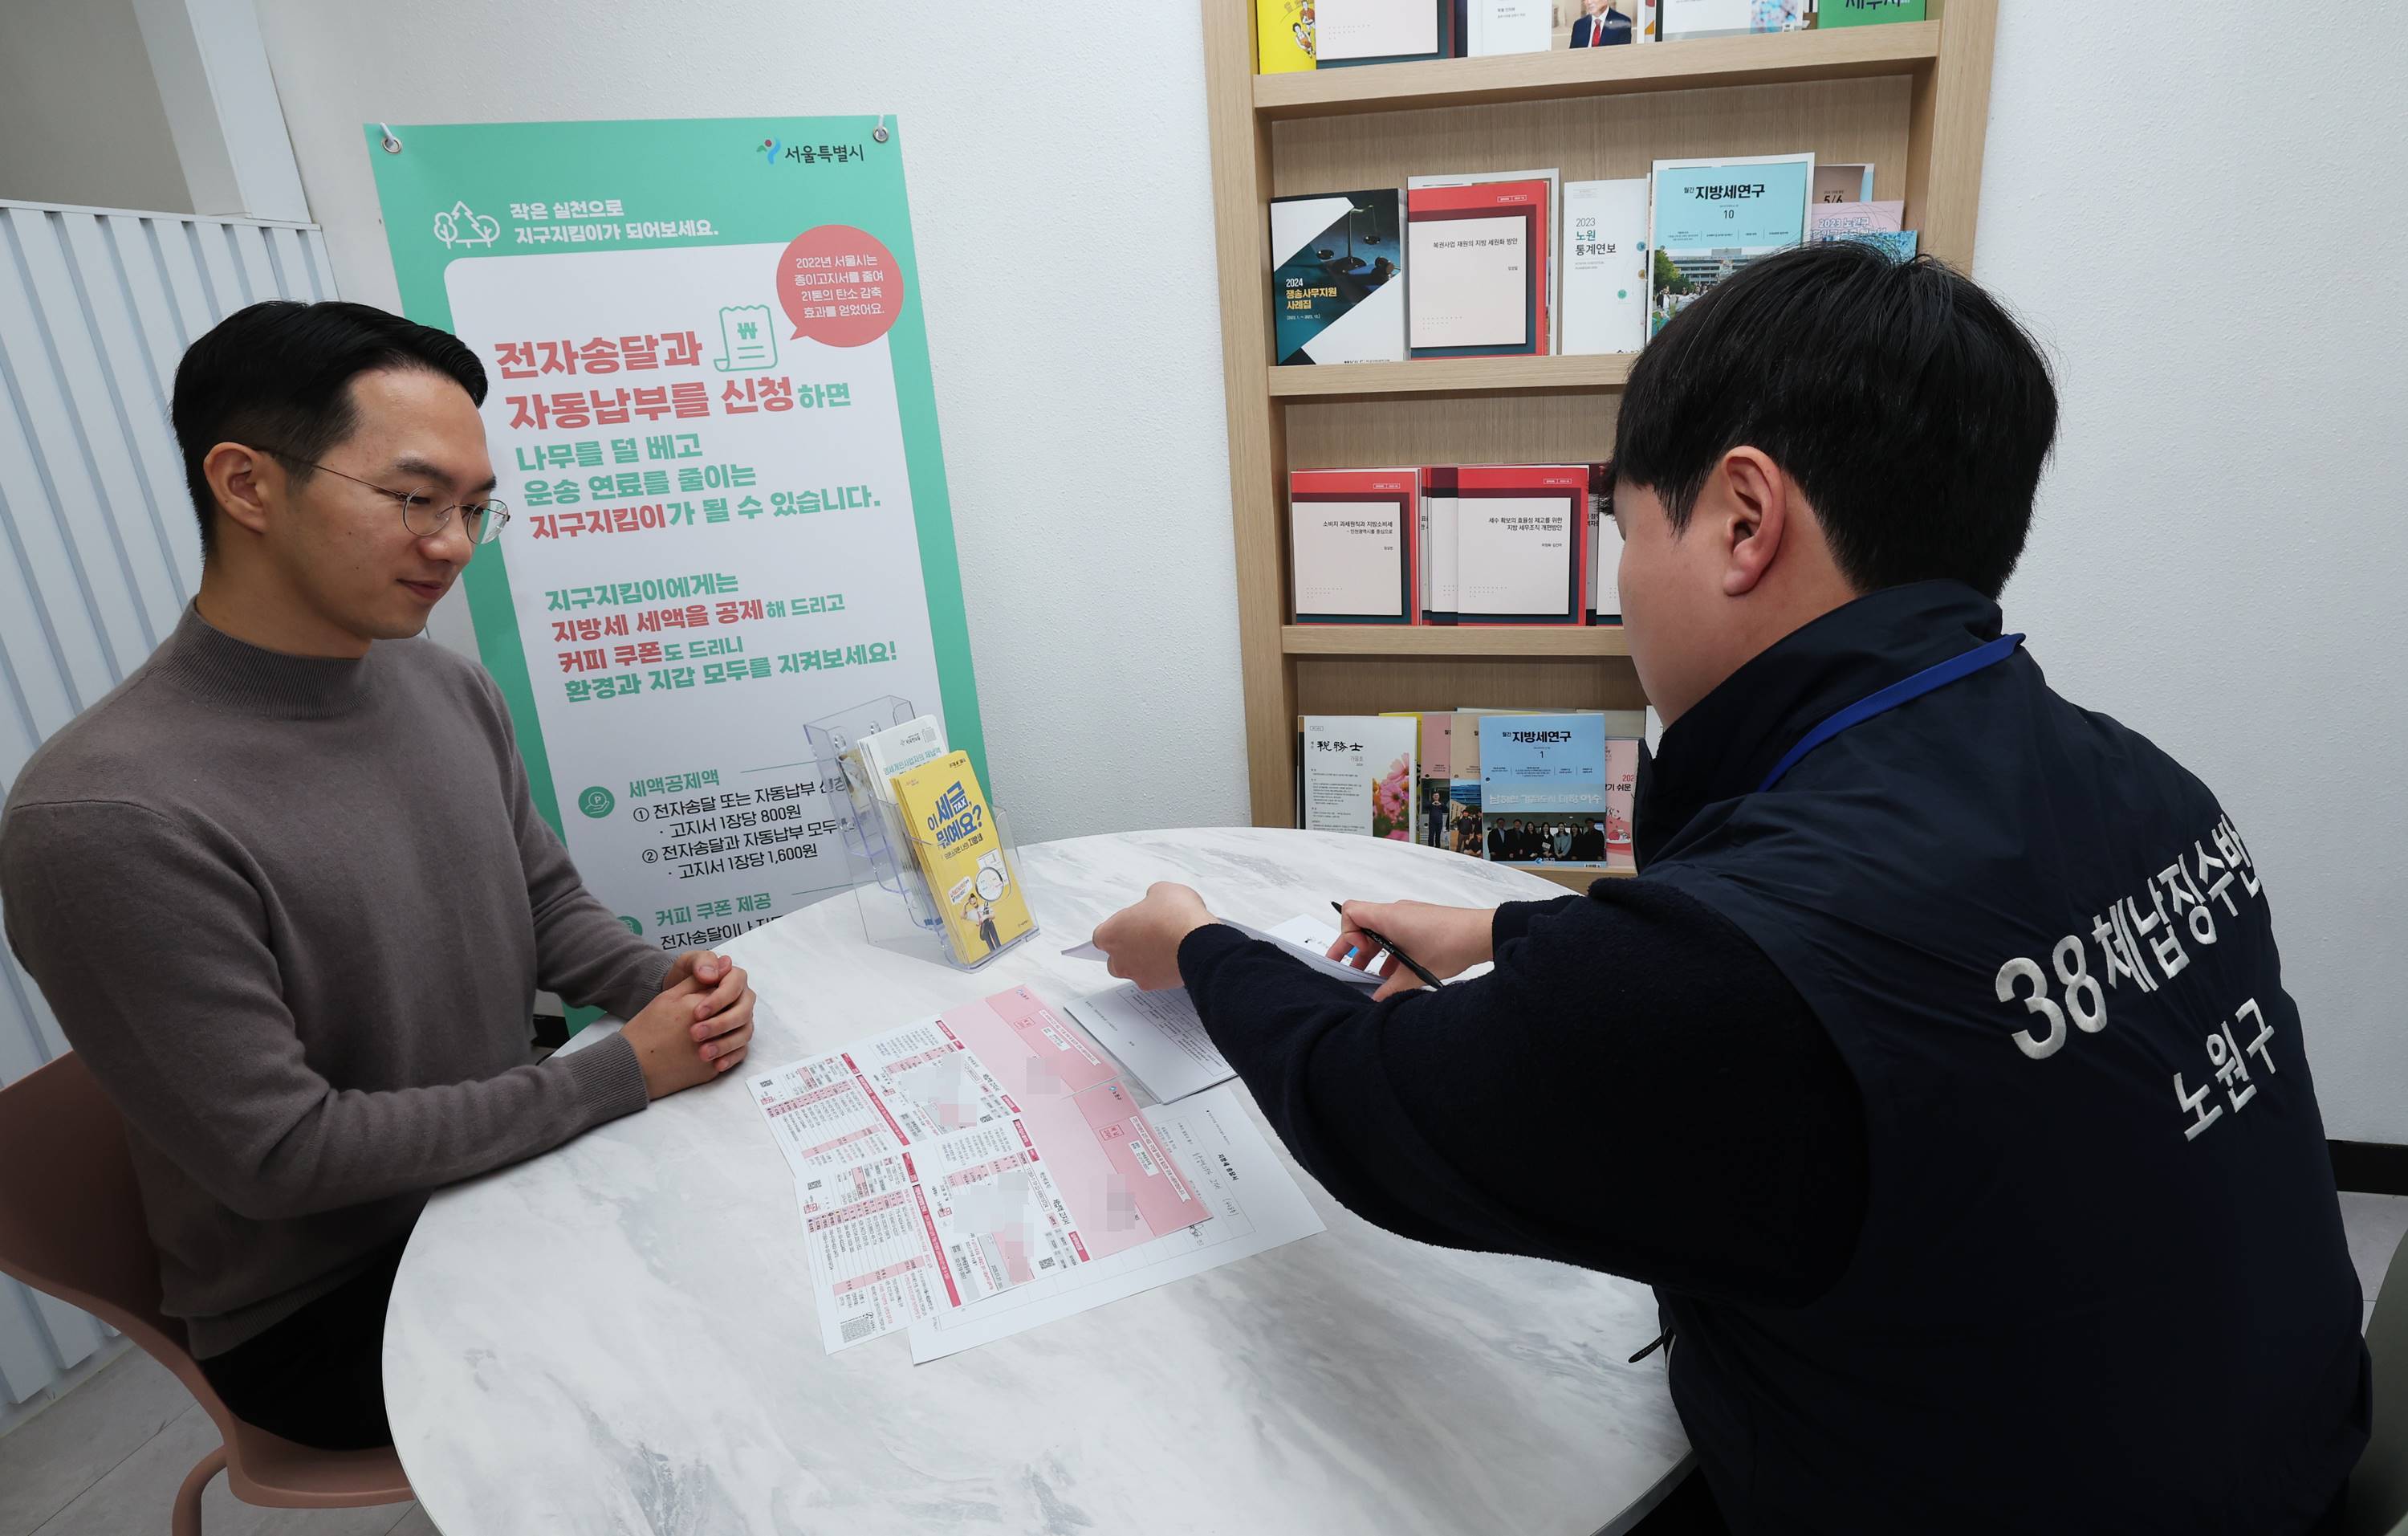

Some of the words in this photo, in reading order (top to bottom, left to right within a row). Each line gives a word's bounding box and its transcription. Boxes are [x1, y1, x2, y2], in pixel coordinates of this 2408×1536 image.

[784, 143, 864, 163] 서울특별시
[1695, 184, 1765, 200] 지방세연구
[510, 202, 548, 220] 작은
[553, 199, 624, 219] 실천으로
[1724, 210, 1734, 219] 10
[1576, 218, 1596, 227] 2023
[1819, 218, 1841, 228] 2023
[1844, 217, 1870, 227] 노원구
[515, 224, 620, 244] 지구지킴이가
[626, 219, 718, 239] 되어보세요.
[1576, 230, 1597, 242] 노원
[1575, 243, 1617, 256] 통계연보
[796, 256, 832, 269] 2022년
[835, 255, 878, 268] 서울시는
[795, 271, 860, 287] 종이고지서를
[862, 270, 884, 283] 줄여
[1286, 278, 1304, 287] 2024
[801, 290, 833, 302] 21톤의
[836, 288, 858, 300] 탄소
[860, 287, 882, 299] 감축
[1286, 287, 1337, 299] 쟁송사무지원
[804, 306, 836, 319] 효과를
[839, 304, 885, 317] 얻었어요.
[1287, 300, 1312, 310] 사례집
[494, 330, 703, 380] 전자송달과
[505, 381, 710, 431] 자동납부를
[720, 376, 852, 416] 신청하면
[515, 437, 604, 472] 나무를
[610, 438, 639, 464] 덜
[646, 434, 703, 460] 베고
[523, 480, 581, 507] 운송
[589, 471, 670, 499] 연료를
[677, 463, 756, 494] 줄이는
[530, 495, 696, 540] 지구지킴이가
[703, 499, 731, 524] 될
[737, 495, 763, 520] 수
[769, 485, 881, 518] 있습니다.
[545, 572, 738, 613] 지구지킴이에게는
[551, 615, 628, 643] 지방세
[637, 606, 710, 634] 세액을
[791, 594, 845, 617] 드리고
[558, 649, 608, 674] 커피
[614, 642, 681, 667] 쿠폰도
[688, 637, 744, 660] 드리니
[565, 677, 641, 703] 환경과
[649, 670, 697, 692] 지갑
[703, 658, 772, 686] 모두를
[779, 642, 897, 676] 지켜보세요!
[1512, 731, 1571, 743] 지방세연구
[629, 769, 720, 798] 세액공제액
[1617, 784, 1631, 792] 쉬운
[653, 797, 718, 820] 전자송달
[719, 792, 751, 809] 또는
[755, 781, 816, 805] 자동납부
[954, 797, 967, 813] TAX
[670, 818, 718, 838] 고지서
[721, 813, 757, 832] 1장당
[761, 805, 802, 823] 800원
[927, 813, 938, 830] 이
[662, 835, 740, 862] 전자송달과
[745, 825, 805, 848] 자동납부
[807, 819, 838, 837] 모두
[678, 858, 726, 880] 고지서
[727, 852, 764, 873] 1장당
[768, 843, 818, 865] 1,600원
[655, 908, 691, 926] 커피
[696, 899, 733, 919] 쿠폰
[736, 892, 771, 913] 제공
[2173, 998, 2276, 1141] 노원구
[1215, 1151, 1231, 1167] 지방세
[1051, 1197, 1064, 1212] 체납액
[1057, 1210, 1071, 1225] 고지서
